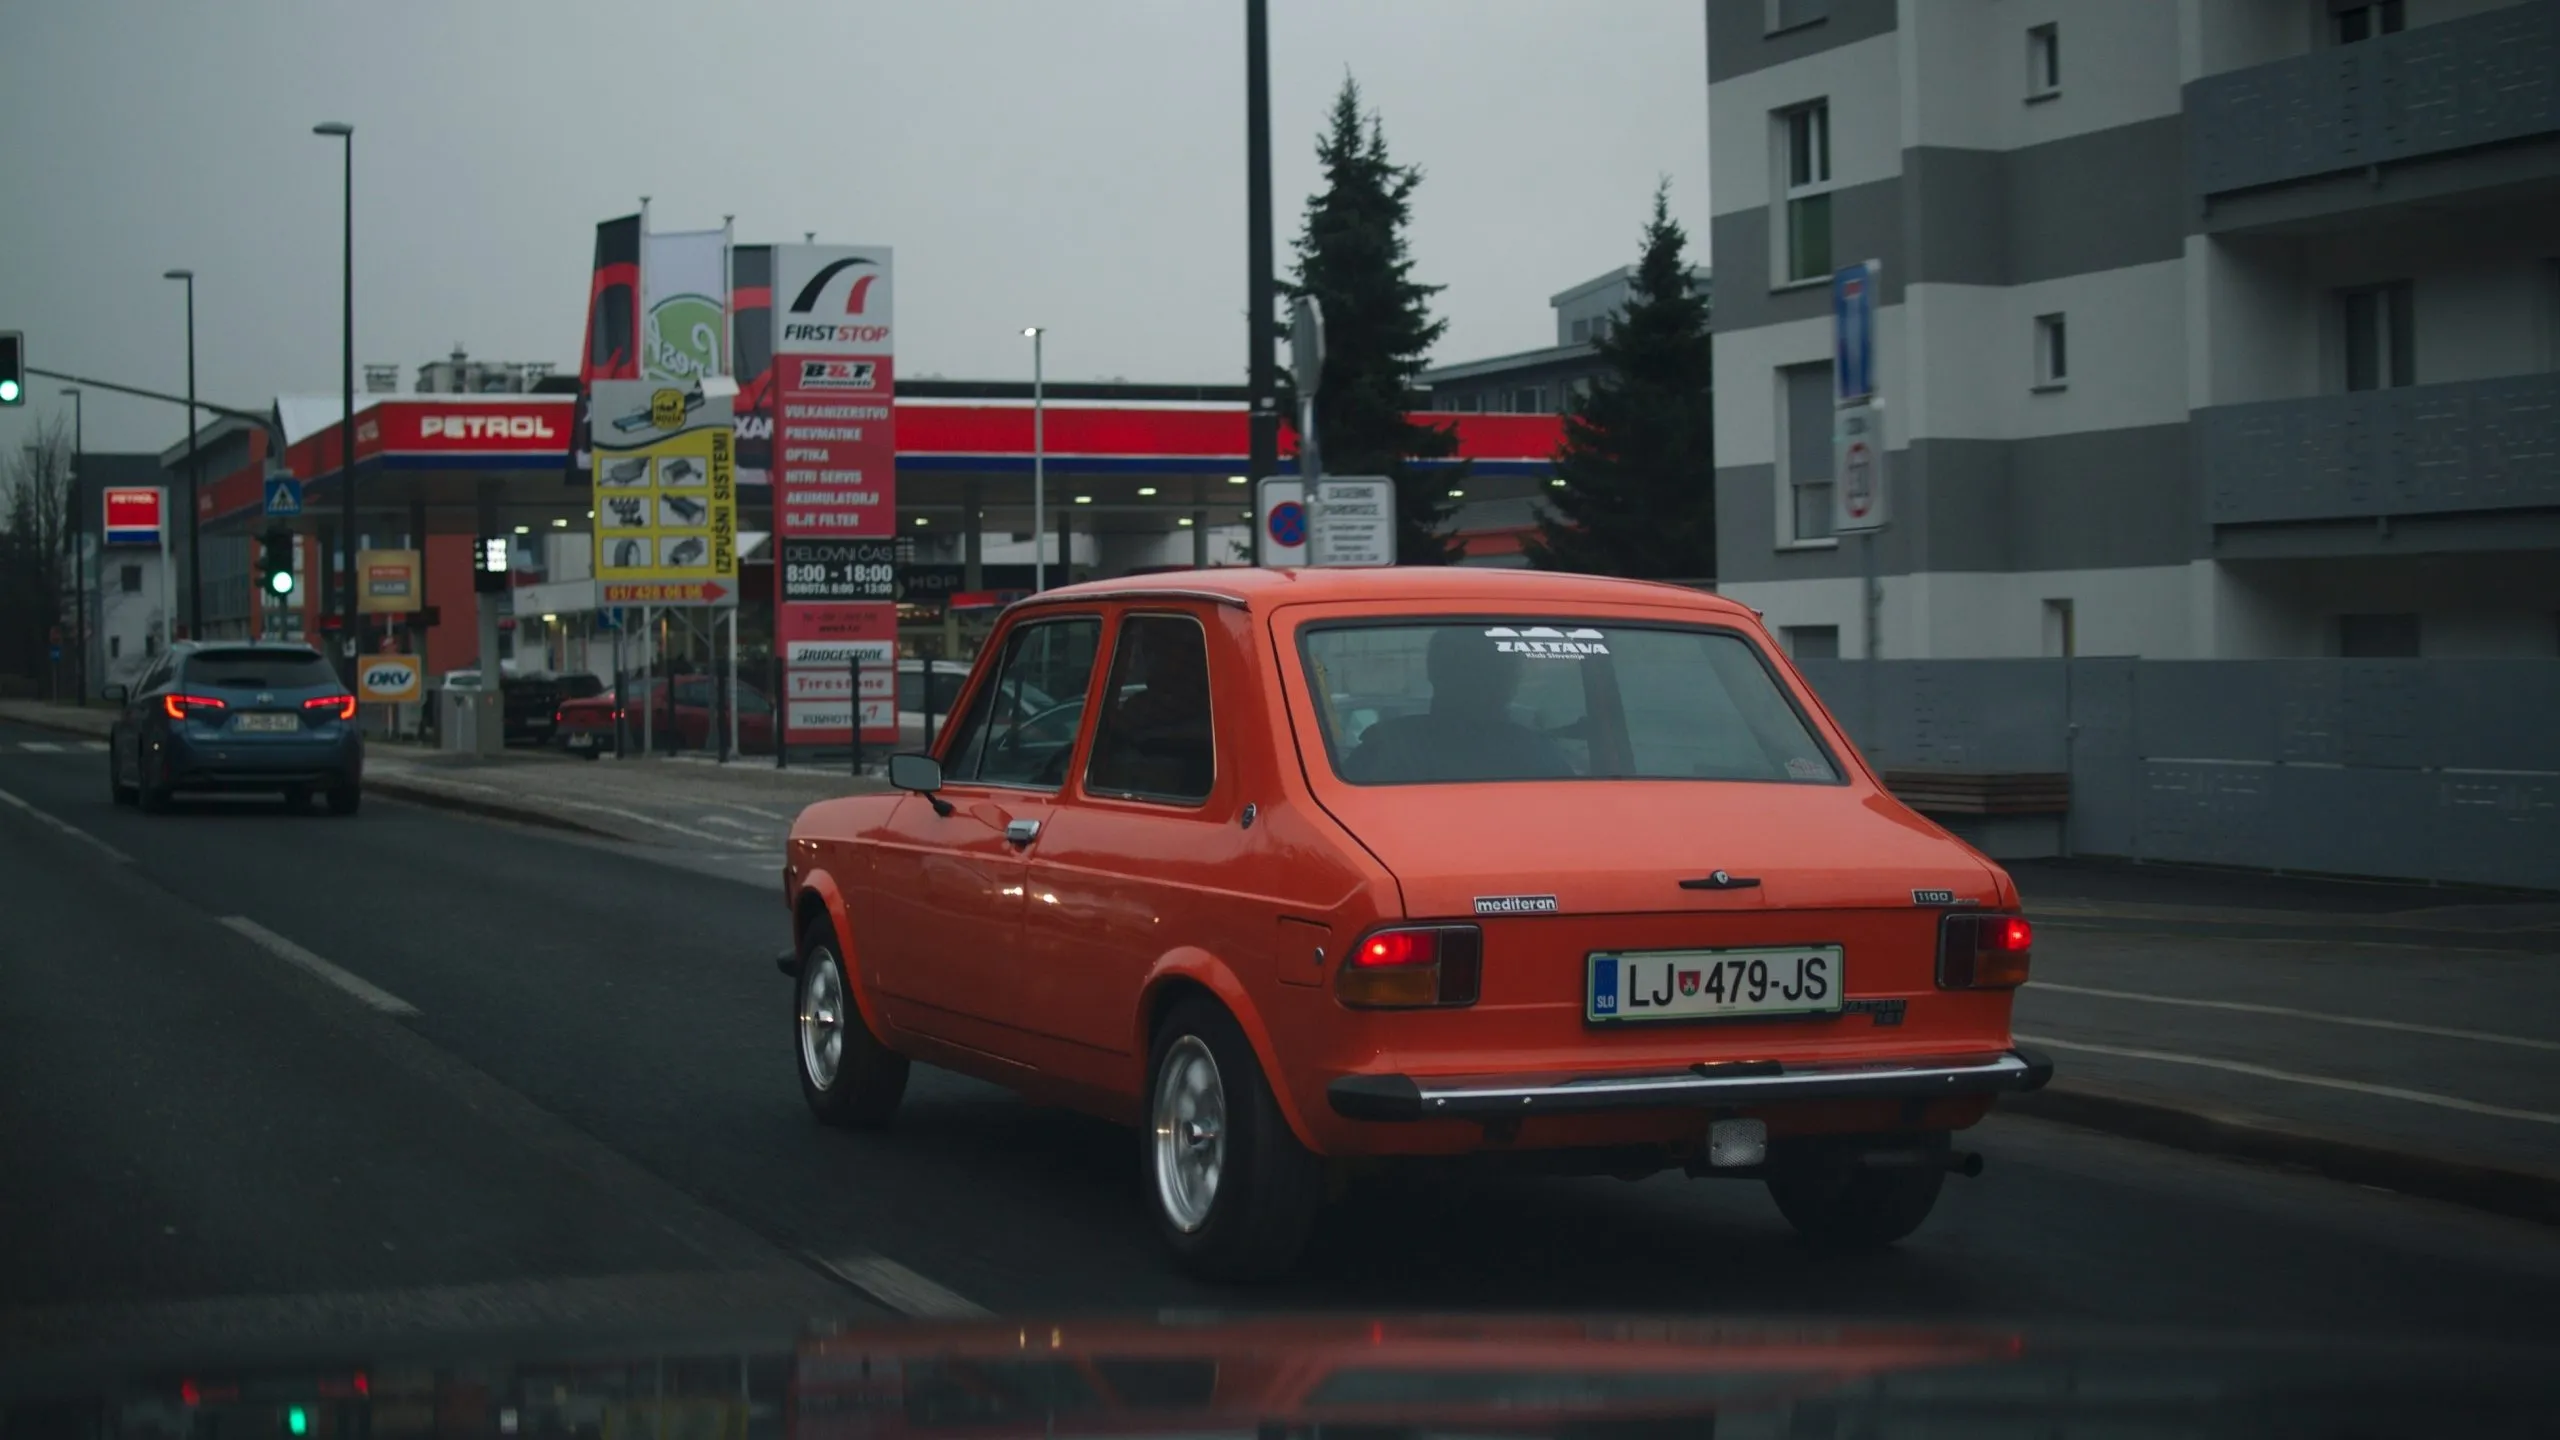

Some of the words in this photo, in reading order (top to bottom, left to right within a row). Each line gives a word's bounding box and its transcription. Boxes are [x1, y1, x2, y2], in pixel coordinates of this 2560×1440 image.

[785, 405, 888, 420] VULKANIZERSTVO
[421, 416, 554, 439] PETROL
[785, 427, 862, 440] PNEVMATIKE
[785, 449, 829, 462] OPTIKA
[713, 432, 731, 501] SISTEMI
[786, 470, 817, 483] HITRI
[820, 470, 862, 484] SERVIS
[786, 492, 879, 505] AKUMULATORJI
[786, 513, 816, 527] OLJE
[819, 513, 859, 527] FILTER
[712, 507, 732, 573] IZPUŠNI
[785, 546, 856, 561] DELOVNI
[858, 543, 893, 561] ČAS
[787, 564, 826, 582] 8:00
[843, 563, 893, 583] 18:00
[786, 583, 829, 595] SOBOTA:
[797, 648, 884, 662] BRIDGESTONE
[1495, 641, 1610, 655] ZASTAVA
[368, 670, 411, 686] DKV
[797, 676, 884, 692] Firestne
[1918, 892, 1949, 901] 1100
[1477, 897, 1556, 911] mediteran
[1629, 963, 1674, 1007] LJ
[1705, 957, 1827, 1004] 479-JS
[1597, 996, 1614, 1008] SLO
